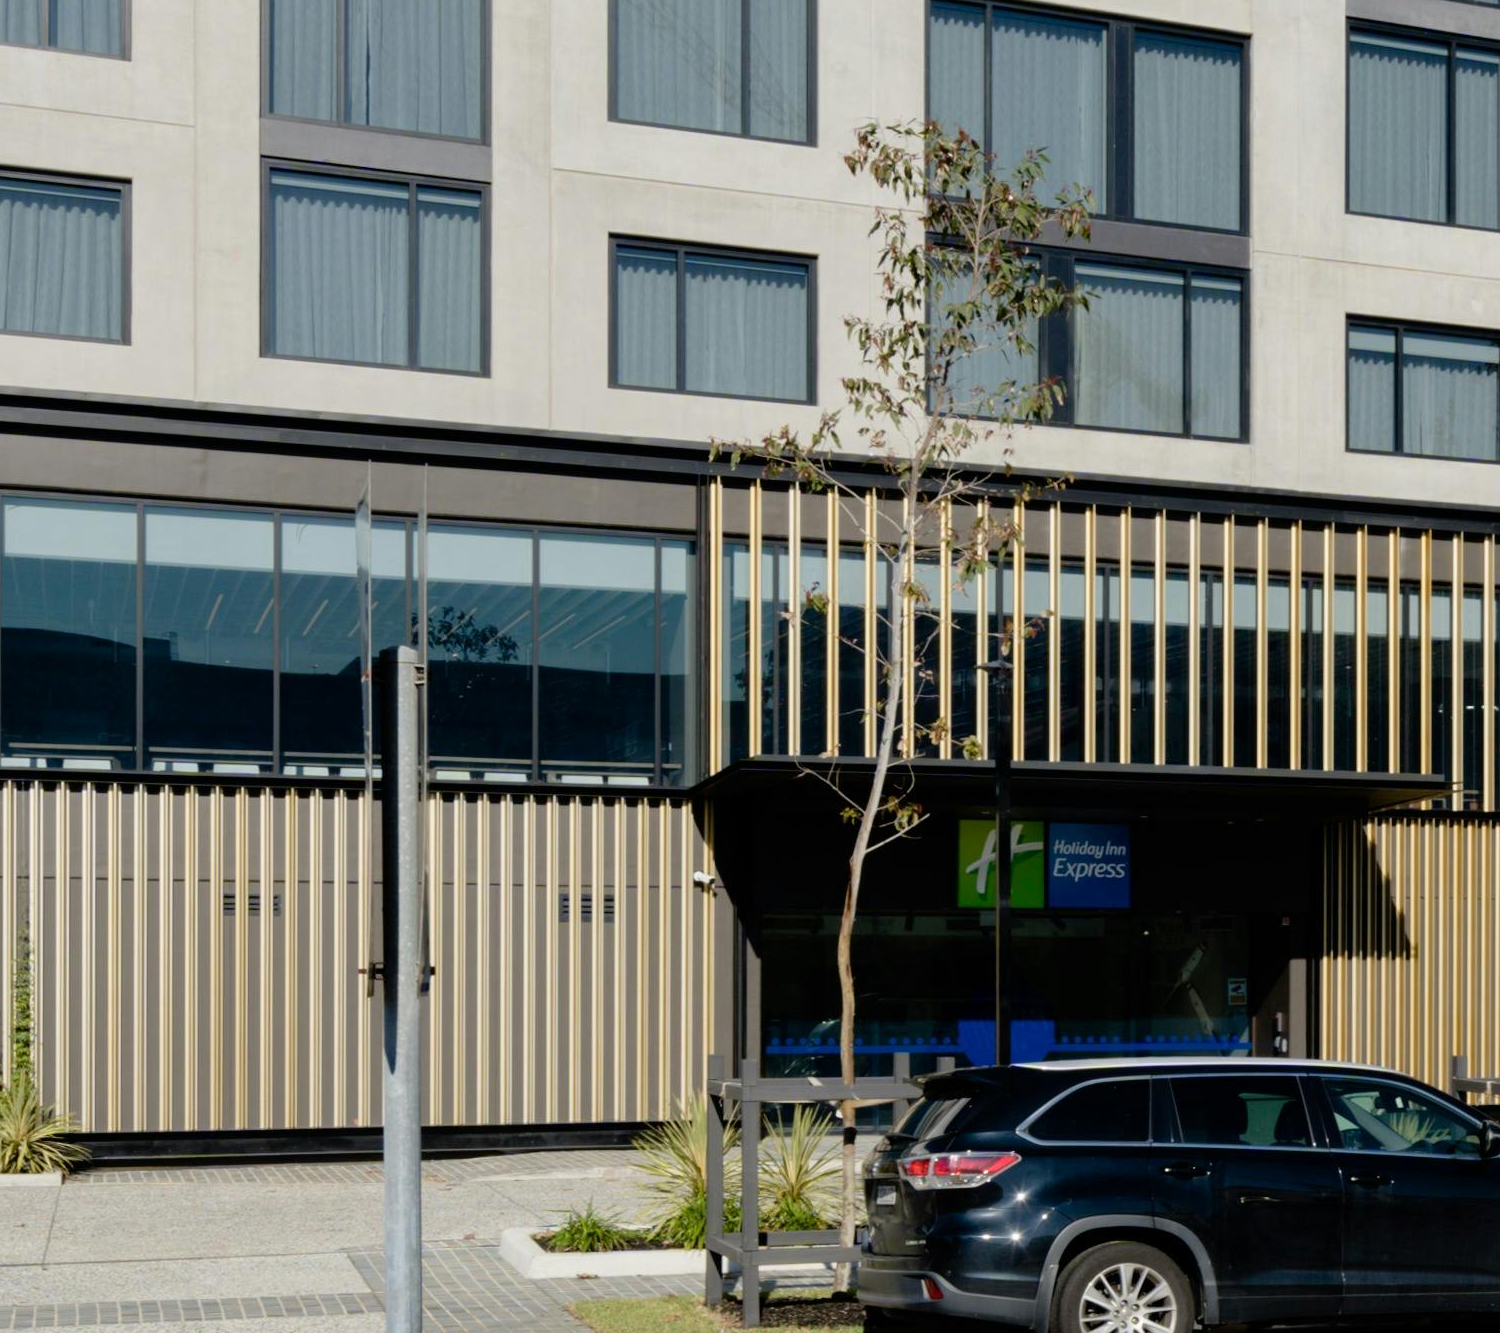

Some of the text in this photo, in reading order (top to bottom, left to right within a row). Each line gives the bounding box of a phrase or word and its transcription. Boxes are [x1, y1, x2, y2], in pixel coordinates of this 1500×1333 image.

[1054, 840, 1126, 859] Holiday Inn
[1052, 858, 1126, 882] Express
